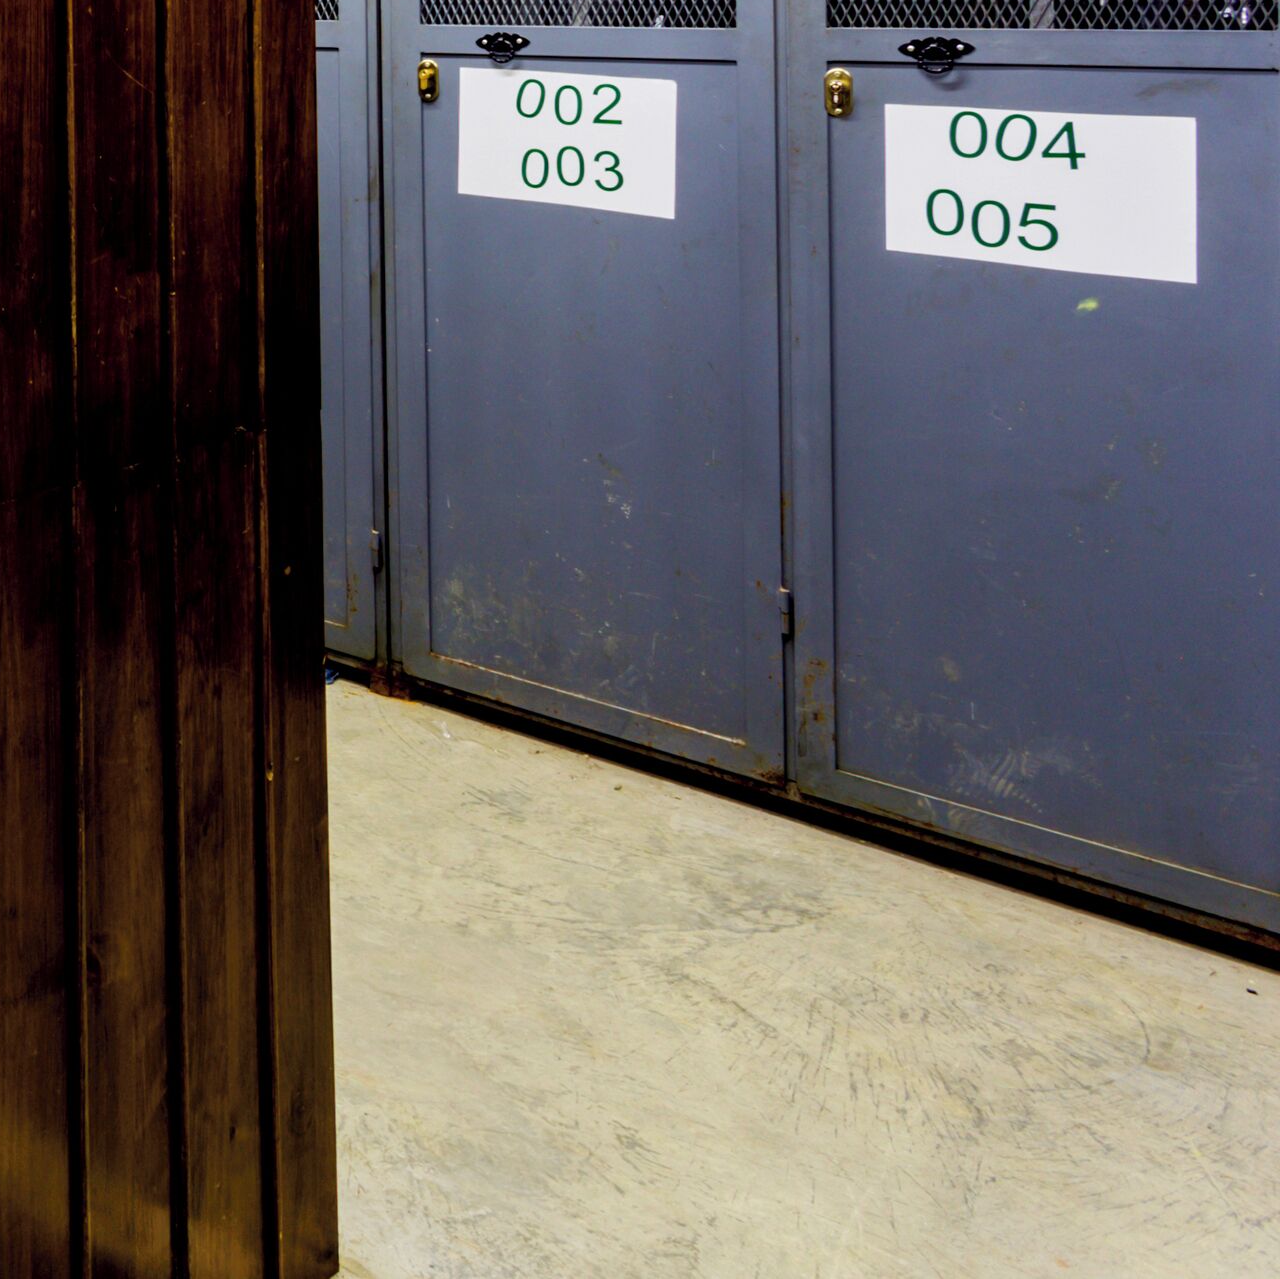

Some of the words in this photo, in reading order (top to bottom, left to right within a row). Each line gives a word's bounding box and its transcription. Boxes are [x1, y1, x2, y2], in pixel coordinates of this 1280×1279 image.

[515, 78, 624, 126] 002
[948, 110, 1086, 171] 004
[521, 145, 625, 193] 003
[926, 188, 1060, 252] 005
